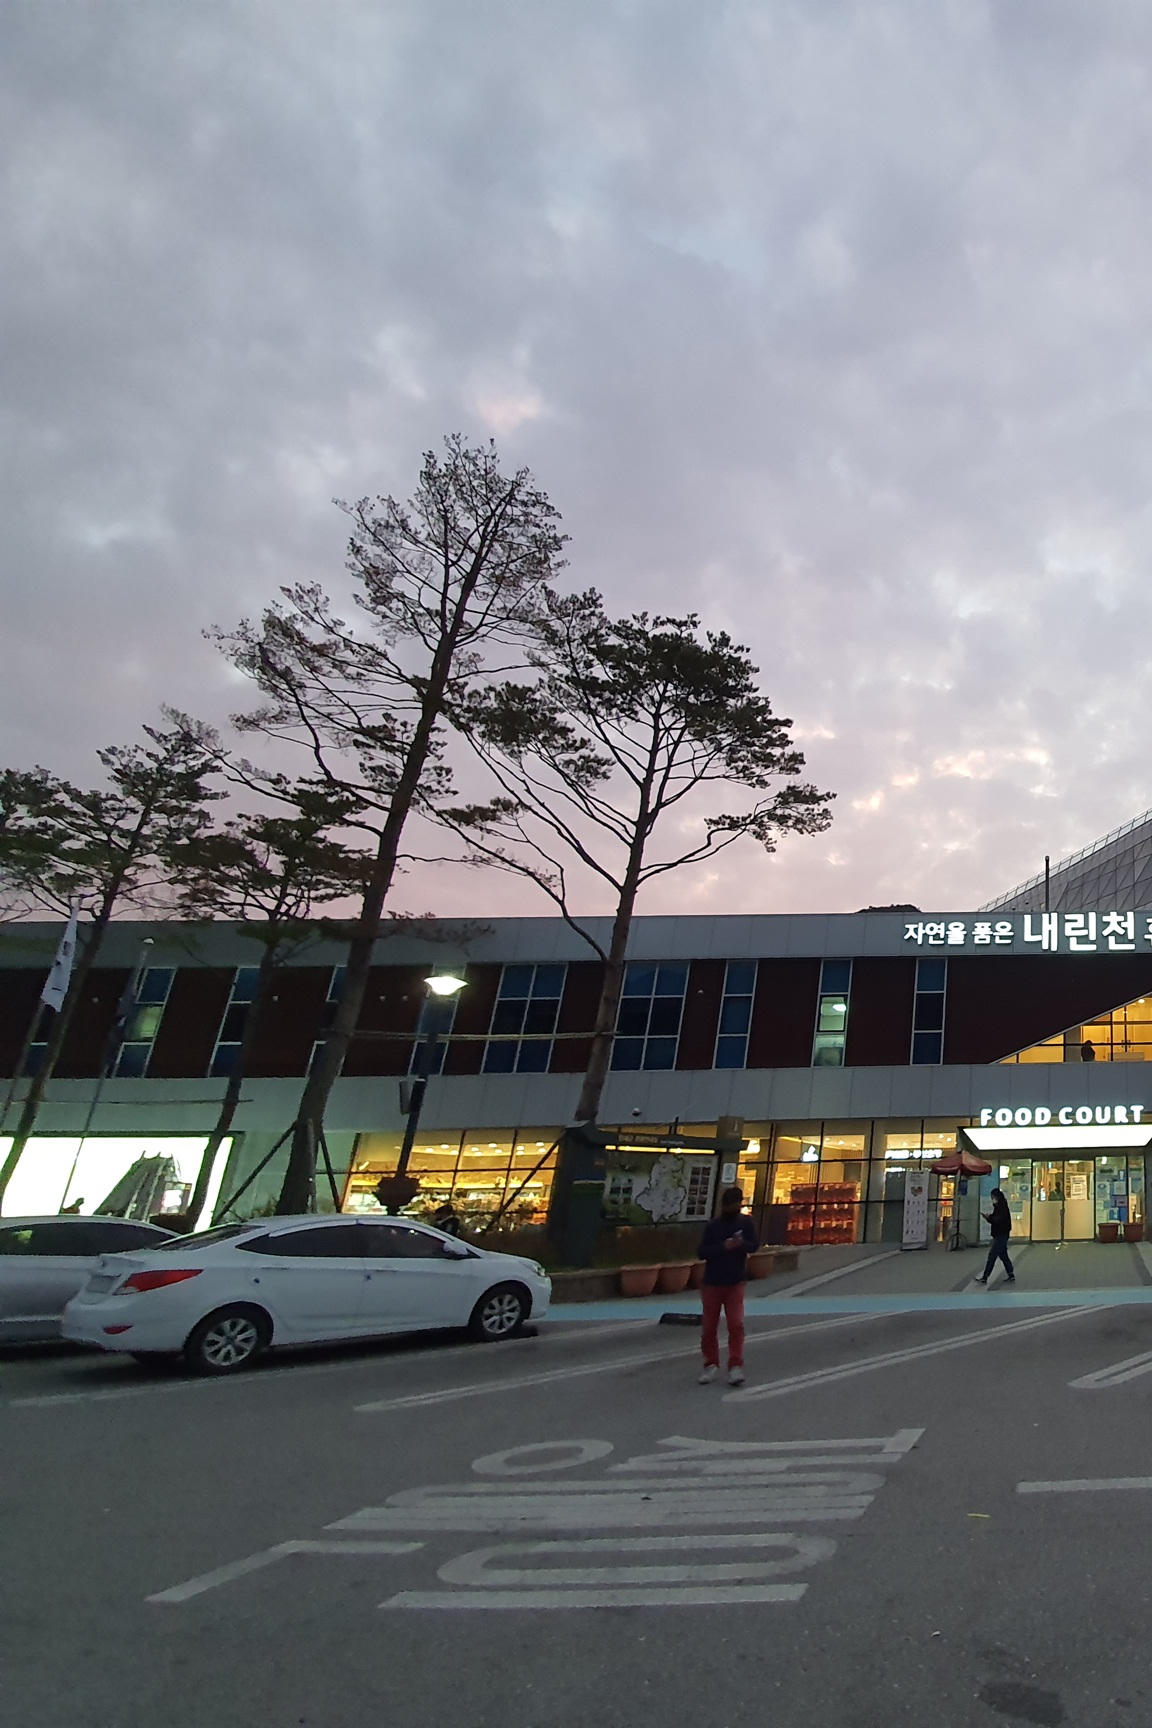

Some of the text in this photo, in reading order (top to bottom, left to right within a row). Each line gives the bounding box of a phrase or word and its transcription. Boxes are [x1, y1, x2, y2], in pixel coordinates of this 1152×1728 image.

[903, 921, 967, 945] 자연을
[971, 921, 1015, 944] 품은
[1023, 911, 1137, 951] 내린천
[980, 1104, 1145, 1127] FOOD COURT
